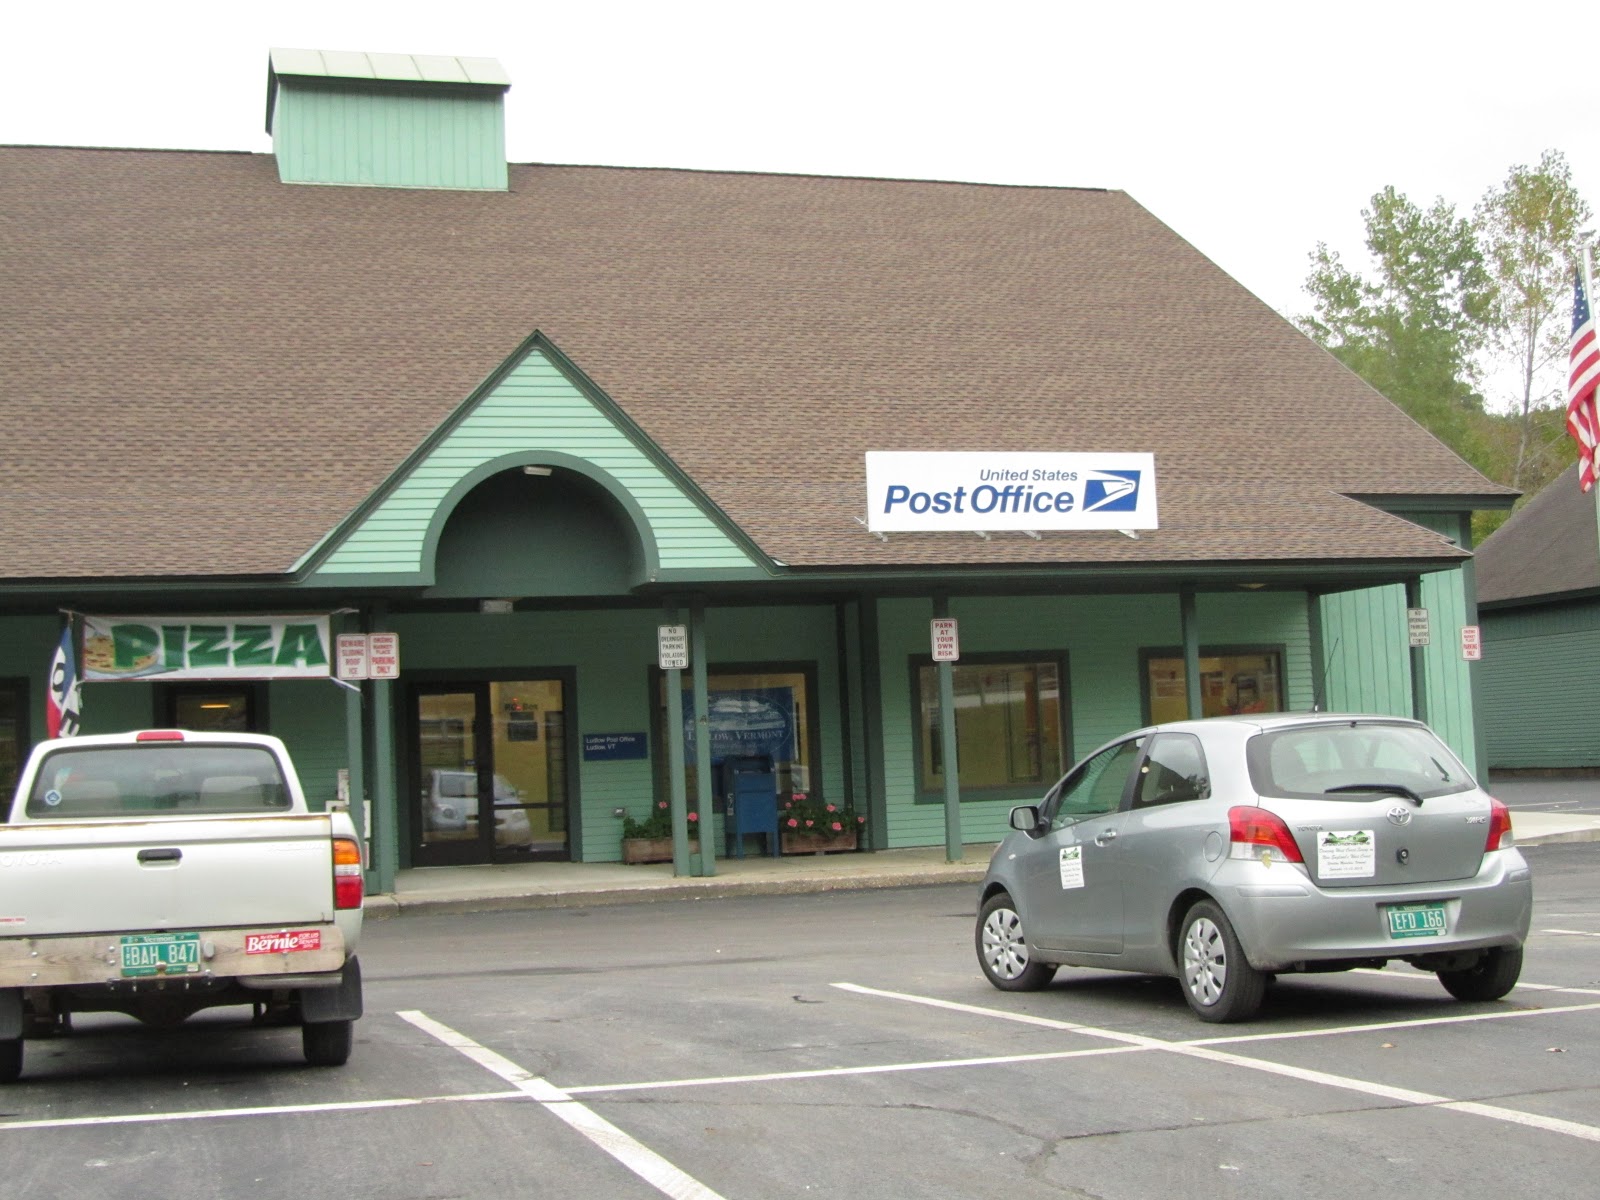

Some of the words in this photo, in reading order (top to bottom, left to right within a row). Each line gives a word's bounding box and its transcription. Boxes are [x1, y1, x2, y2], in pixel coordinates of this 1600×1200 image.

[980, 468, 1028, 481] United
[1032, 468, 1079, 481] States
[884, 485, 967, 514] Post
[971, 484, 1074, 514] Office
[111, 623, 330, 670] PIZZA
[371, 656, 395, 664] PARKING
[376, 666, 391, 674] ONLY
[1394, 912, 1416, 930] EFD
[1421, 910, 1443, 928] 166
[144, 935, 176, 944] Vermont
[247, 933, 299, 952] Bernie
[131, 945, 160, 966] BAH
[168, 943, 196, 964] 847
